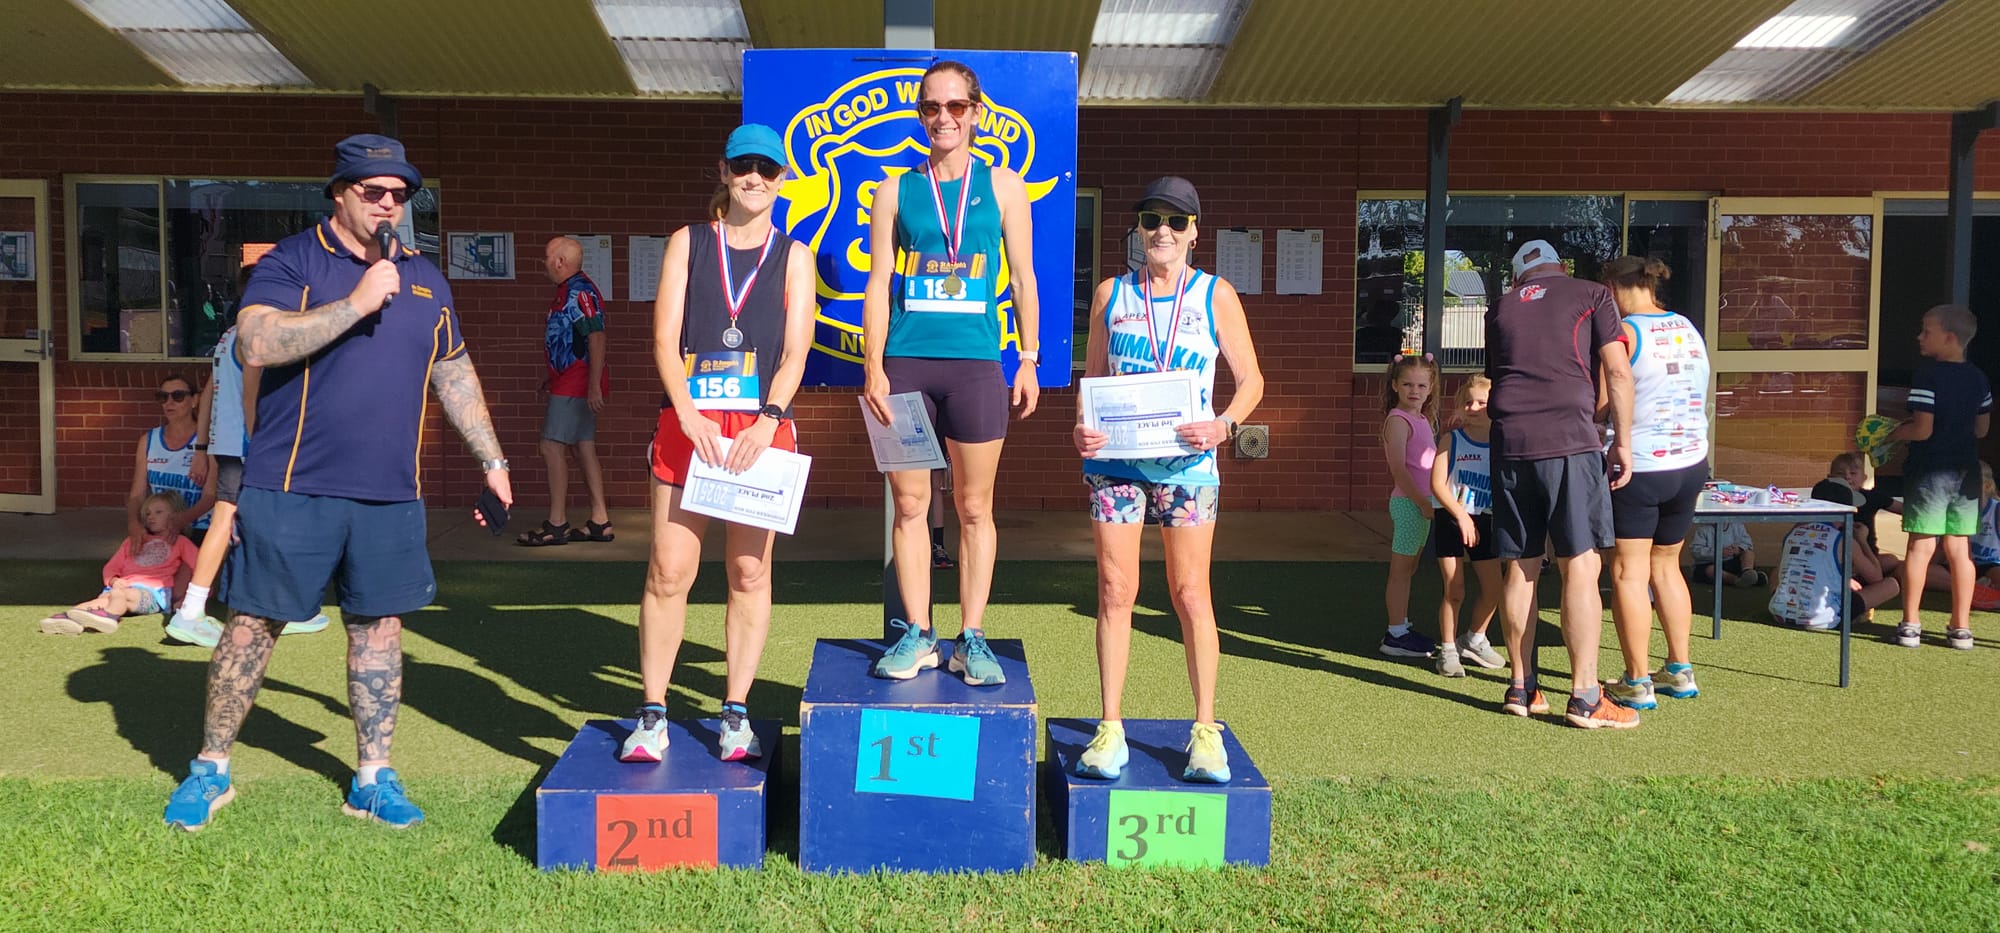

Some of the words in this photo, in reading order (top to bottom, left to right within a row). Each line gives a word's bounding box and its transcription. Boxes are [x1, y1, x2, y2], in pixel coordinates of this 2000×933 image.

[804, 111, 832, 139] IN
[833, 87, 889, 128] GOD
[696, 376, 741, 398] 156
[1136, 421, 1160, 429] PLACE
[737, 487, 759, 498] PLACE
[760, 494, 775, 502] 2nd
[869, 732, 942, 782] 1st
[607, 809, 694, 867] 2nd
[1116, 806, 1197, 861] 3rd
